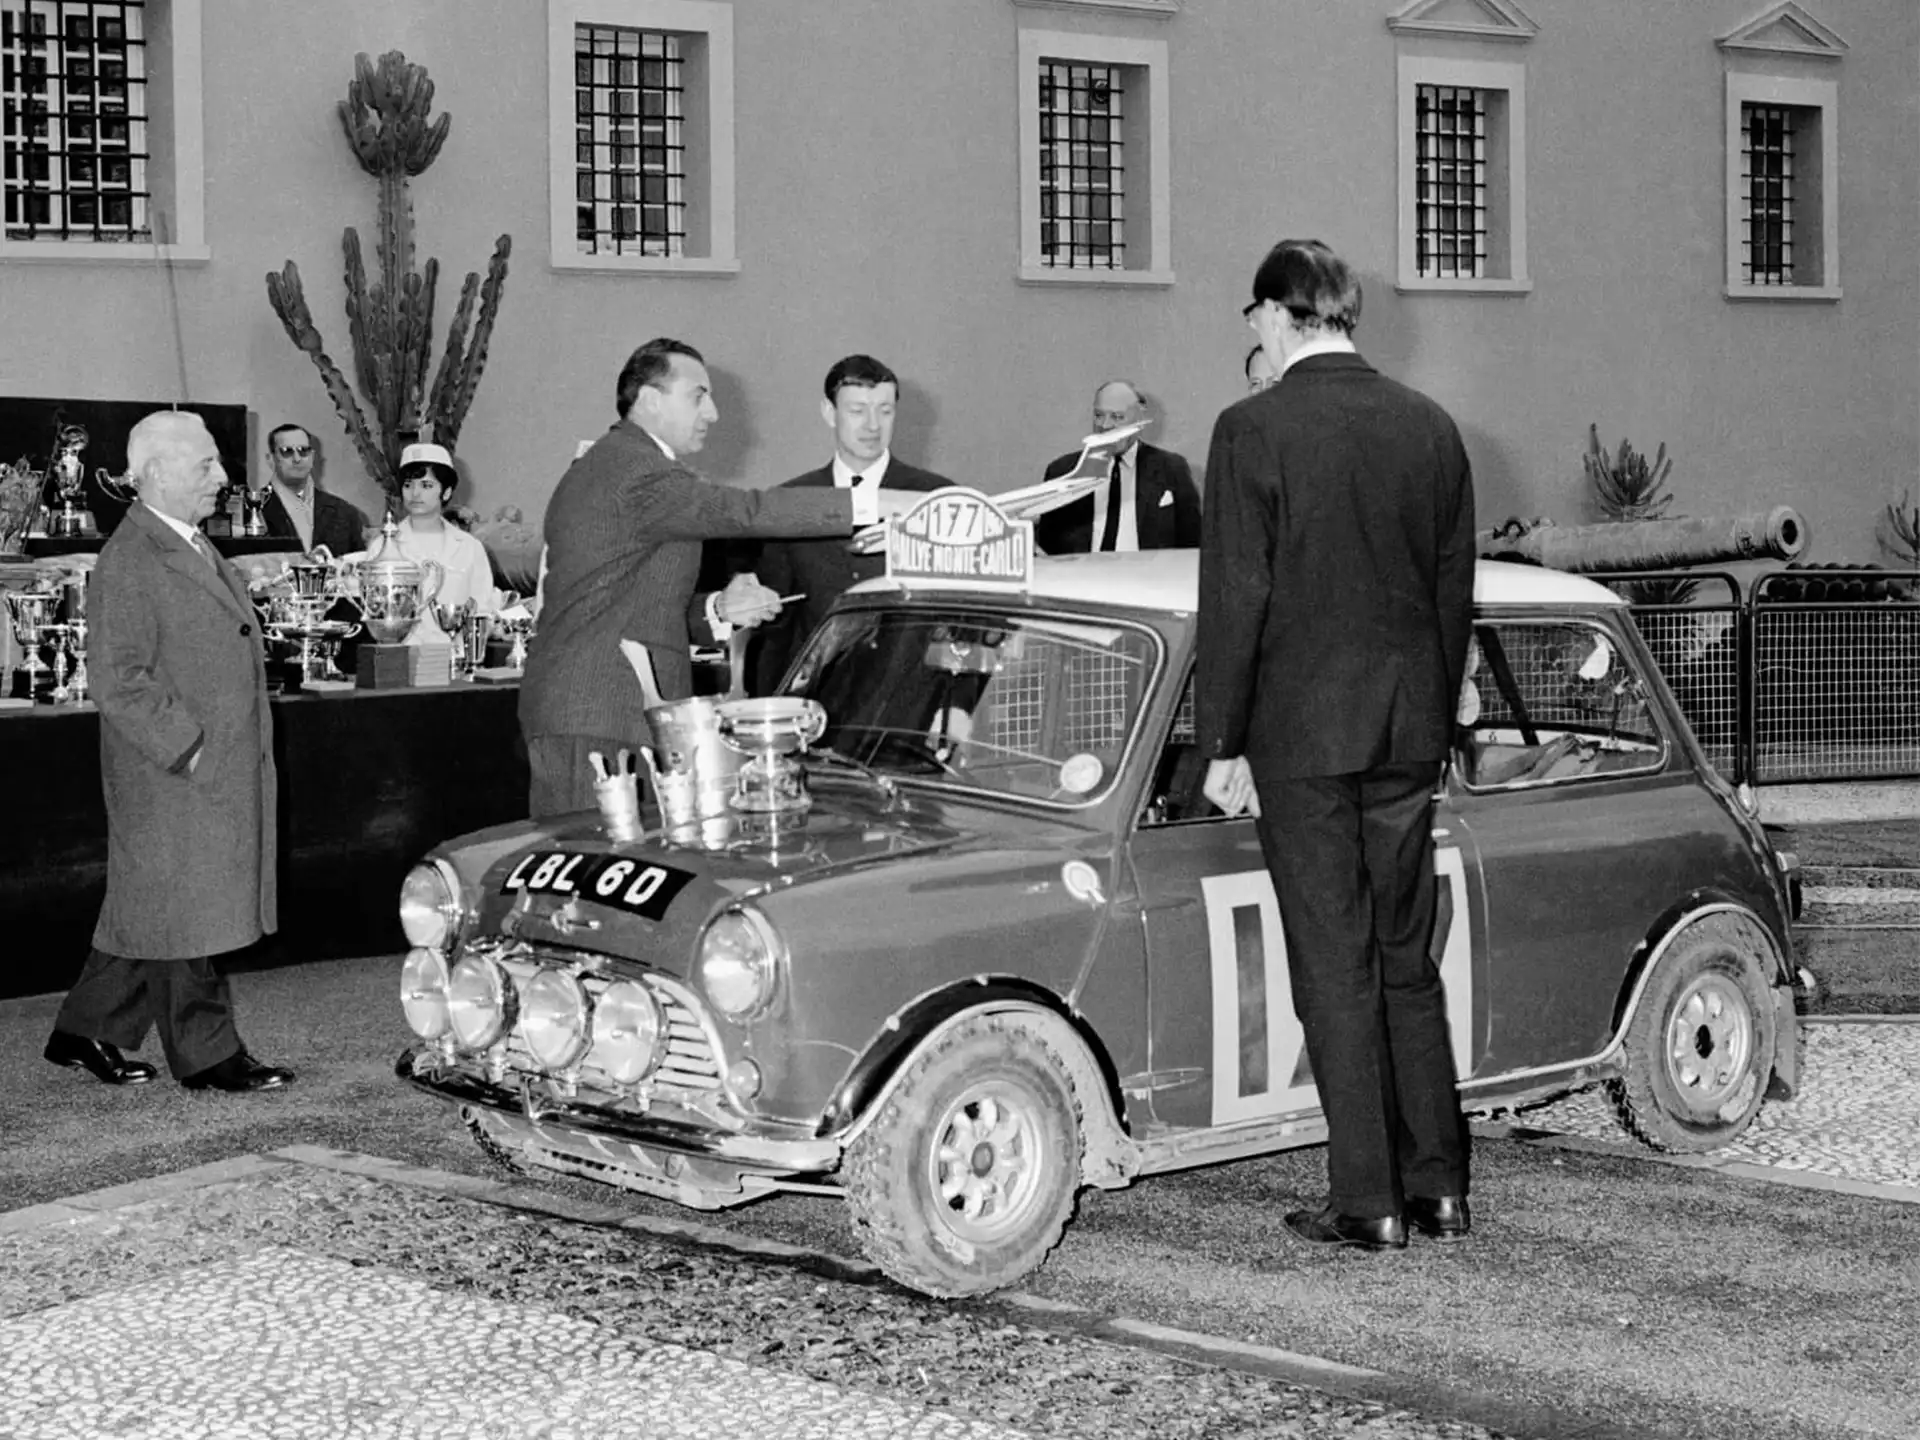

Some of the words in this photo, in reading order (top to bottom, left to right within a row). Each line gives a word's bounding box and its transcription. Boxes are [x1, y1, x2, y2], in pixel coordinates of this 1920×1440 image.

[932, 502, 981, 538] 177
[505, 853, 584, 892] LBL
[595, 859, 668, 906] 6D
